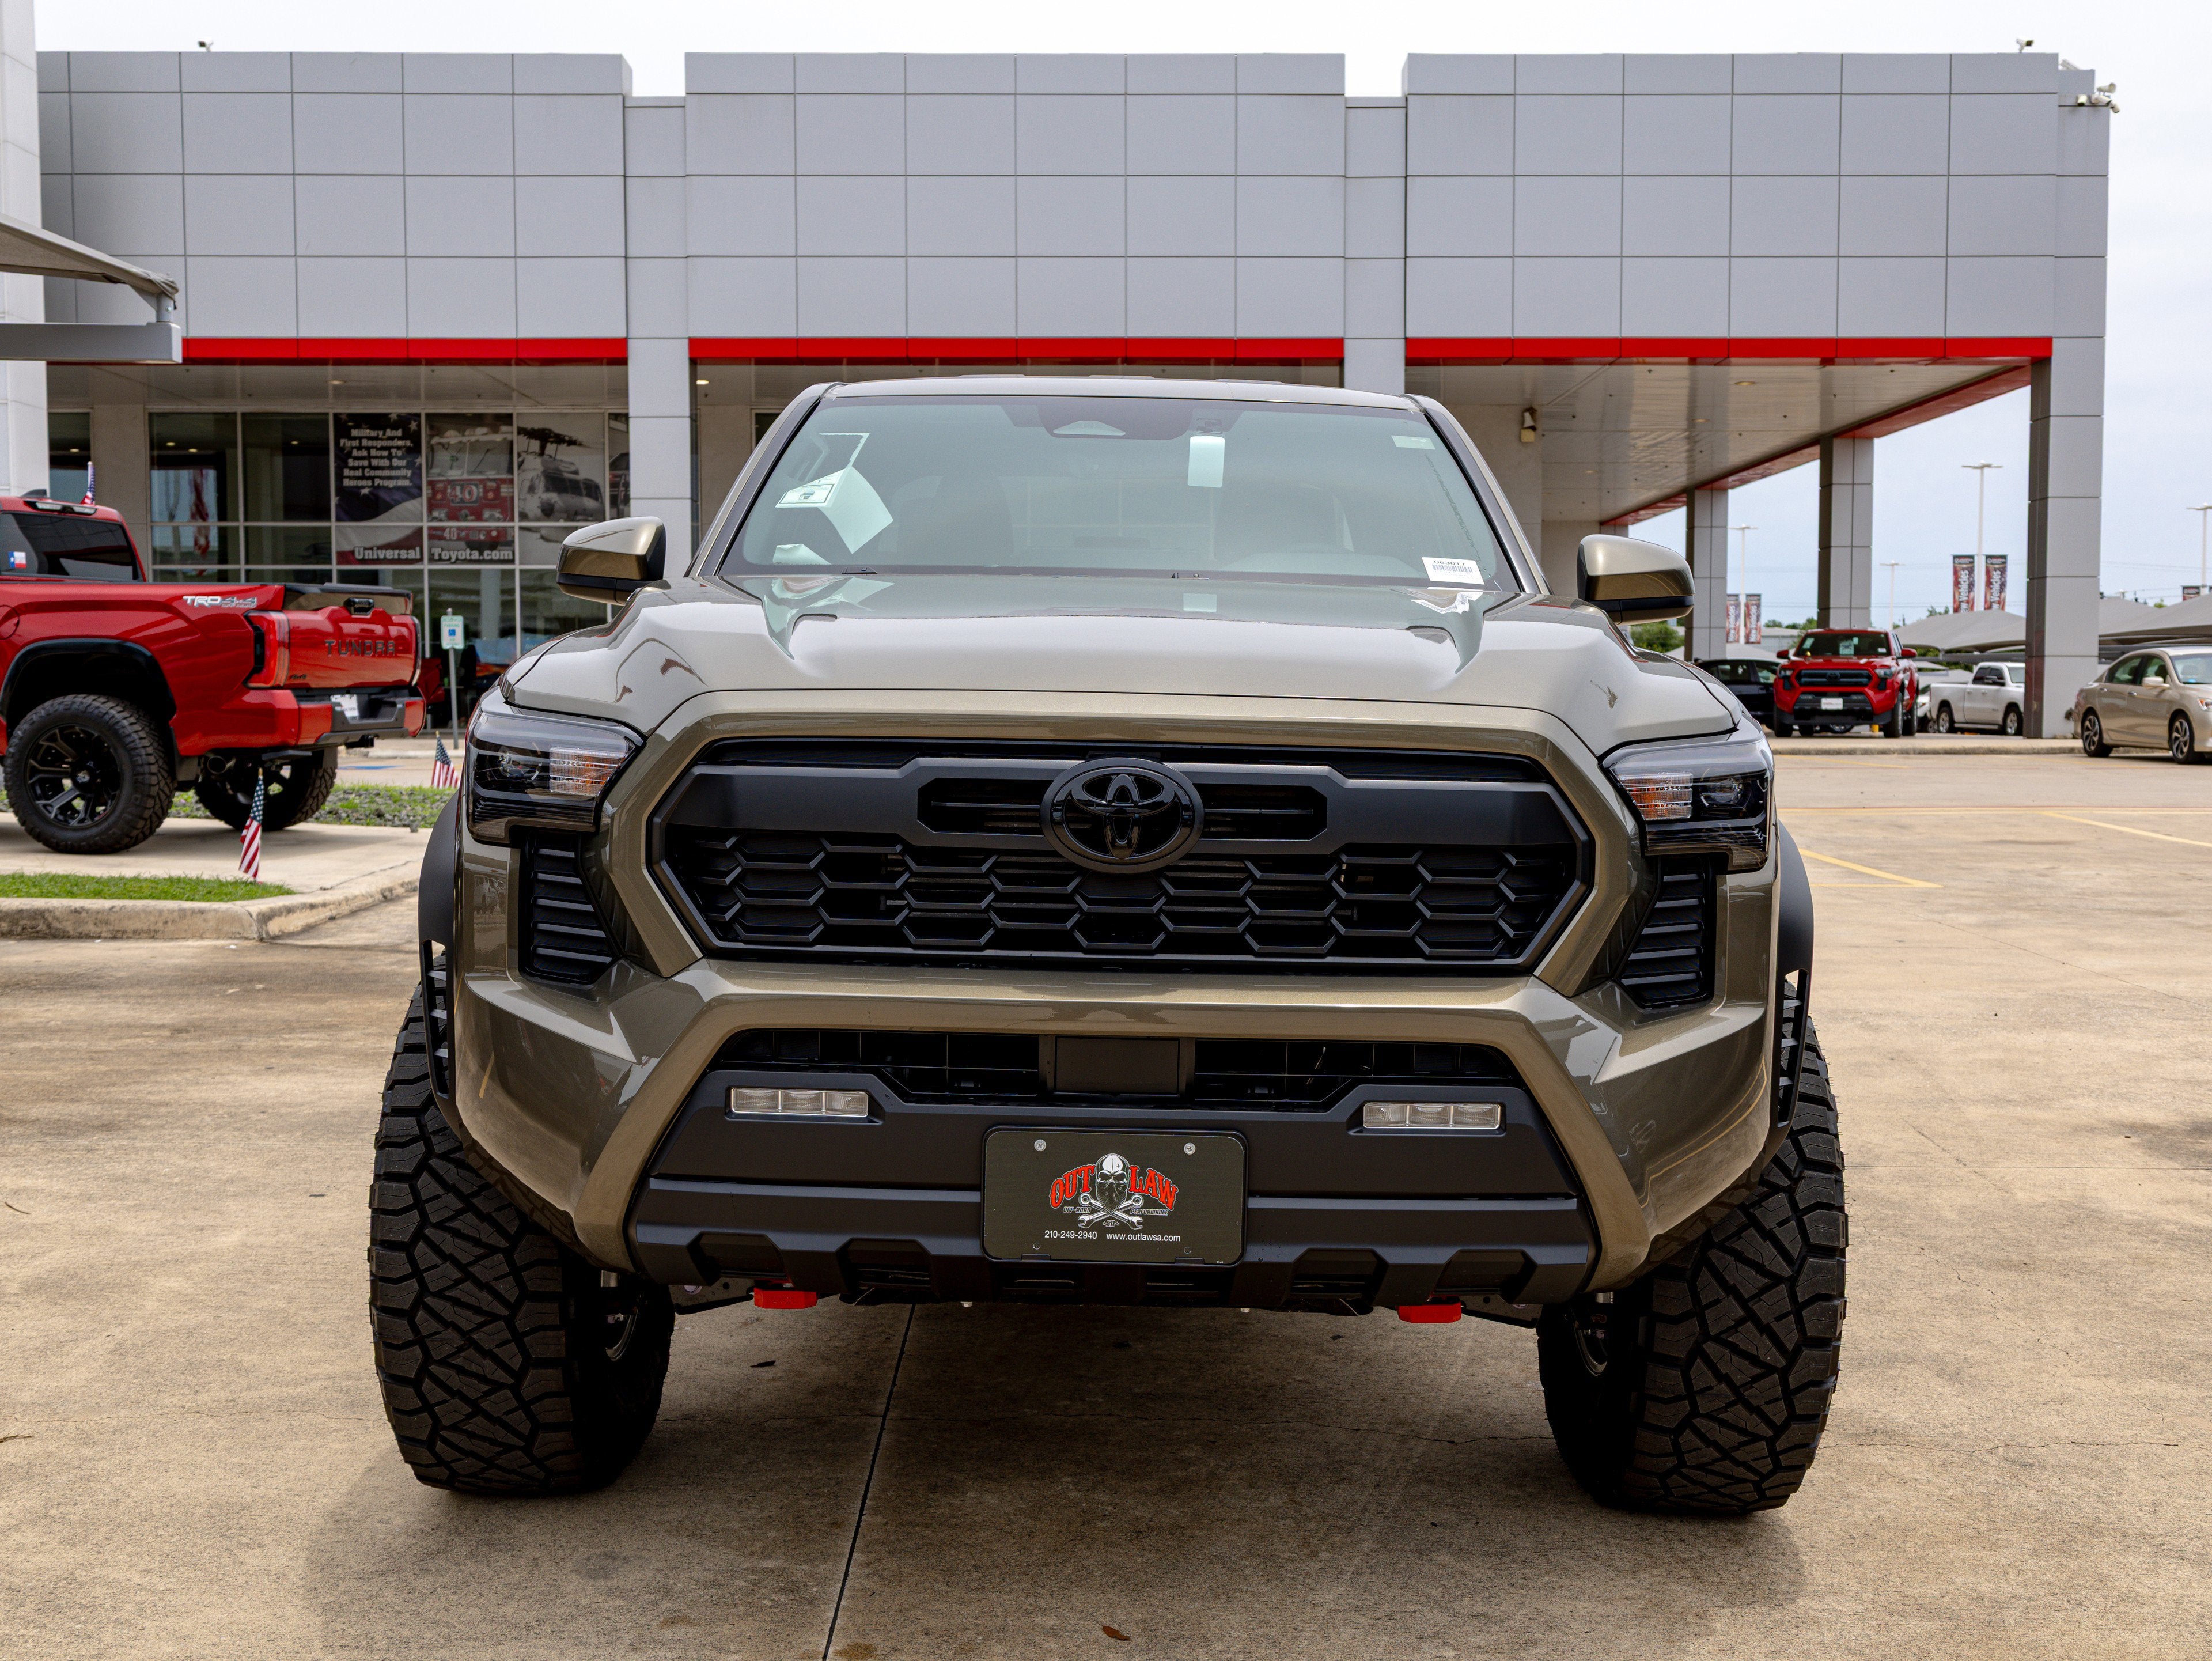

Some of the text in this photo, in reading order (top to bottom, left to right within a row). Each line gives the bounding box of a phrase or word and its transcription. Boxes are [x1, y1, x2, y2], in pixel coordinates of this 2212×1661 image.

[351, 428, 402, 438] Military And
[343, 468, 412, 477] Real Community
[343, 478, 412, 488] Heroes Program.
[354, 547, 513, 563] Universal Toyota.com
[183, 595, 222, 608] TRD
[325, 640, 396, 657] TUNDRA
[1050, 1164, 1179, 1210] OUT LAW
[1044, 1230, 1181, 1242] 210-249-2940 www.outlawsa.com
